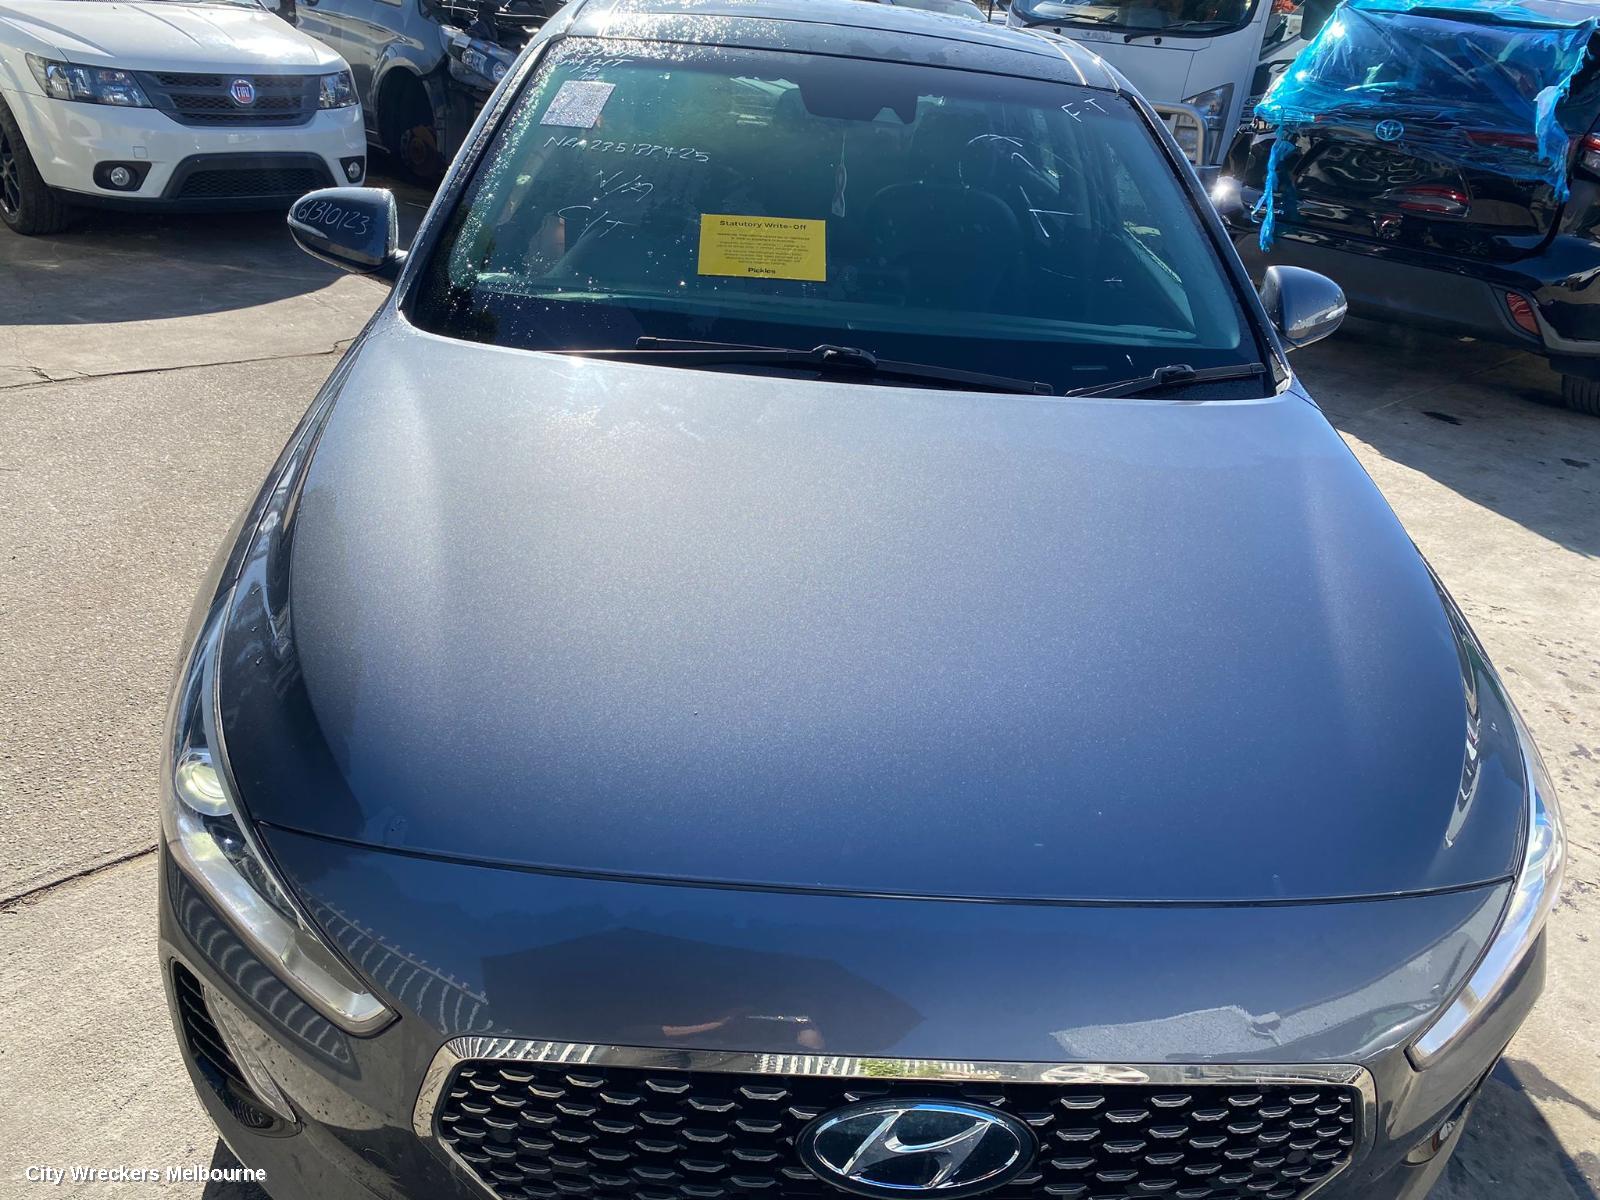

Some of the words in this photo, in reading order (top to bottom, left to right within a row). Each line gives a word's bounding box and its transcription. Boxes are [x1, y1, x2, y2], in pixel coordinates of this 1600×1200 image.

[719, 220, 762, 229] Statutory
[764, 222, 807, 231] Write-Off
[747, 266, 776, 275] Pickles
